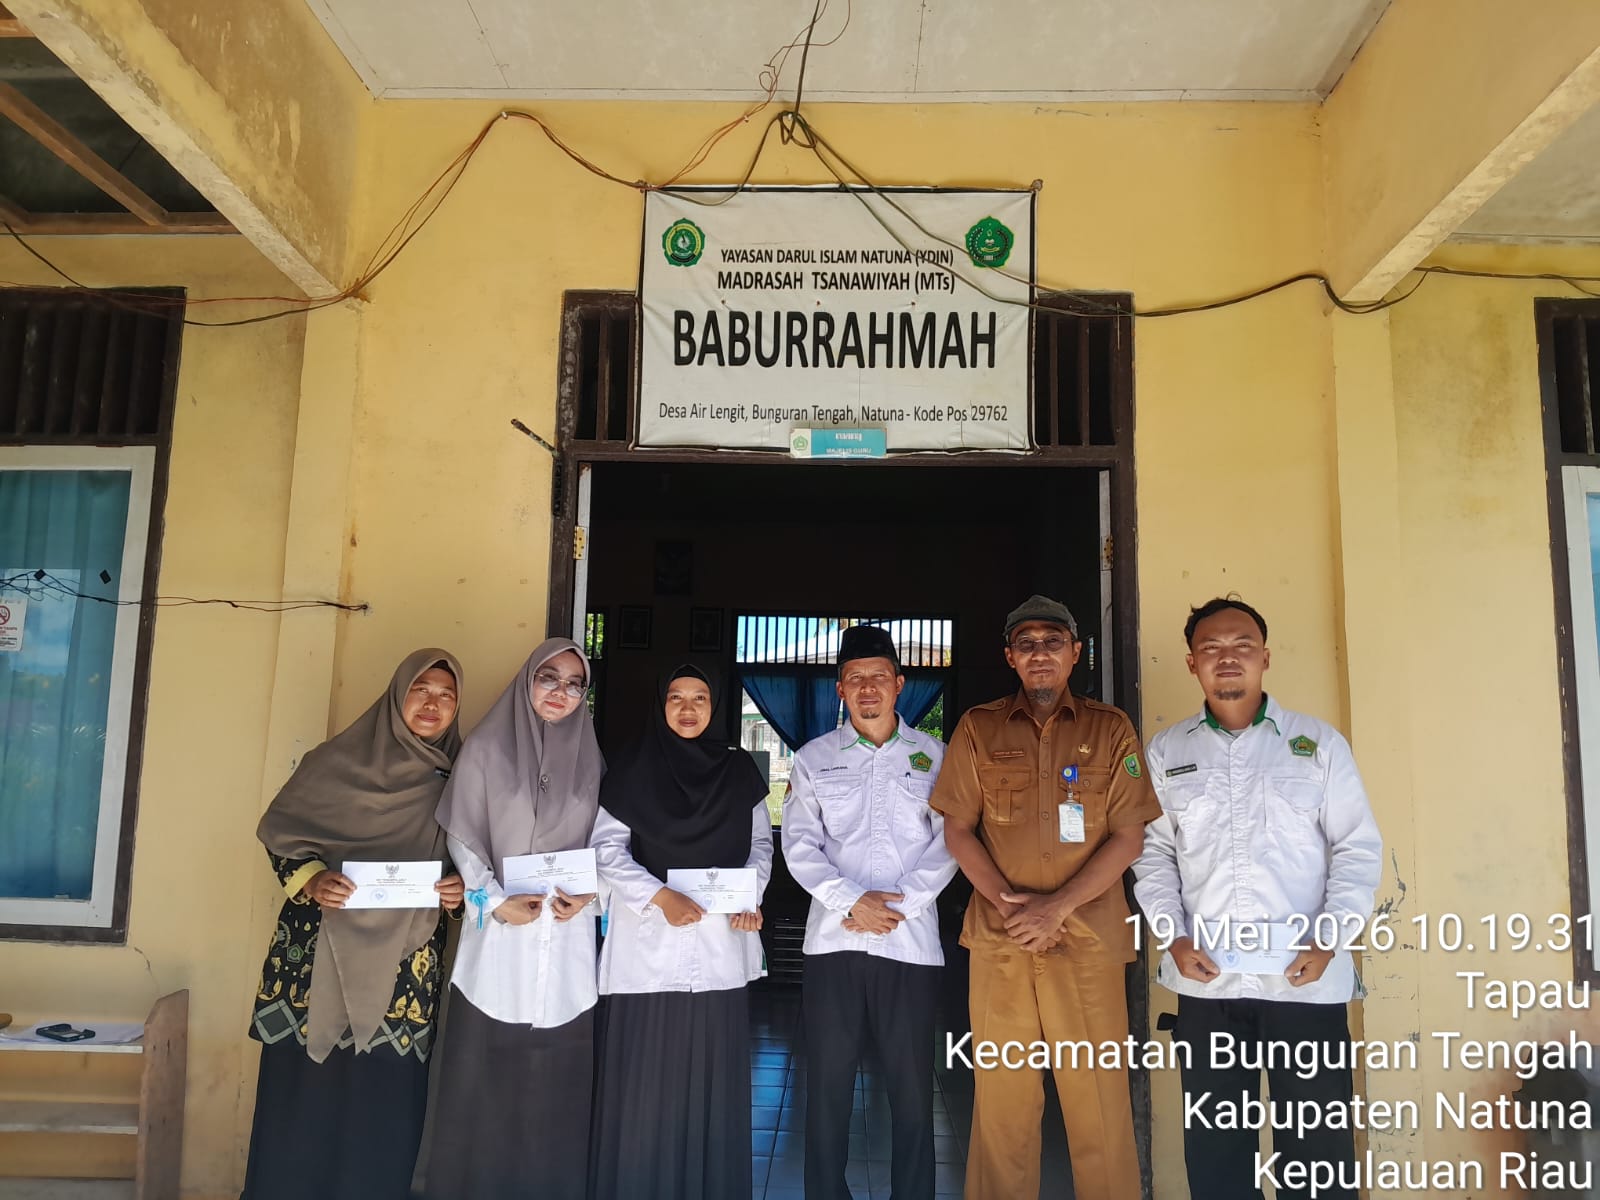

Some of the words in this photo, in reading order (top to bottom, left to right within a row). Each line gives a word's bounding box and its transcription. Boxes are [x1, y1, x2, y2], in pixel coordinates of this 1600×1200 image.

[720, 249, 774, 264] YAYASAN
[776, 249, 817, 264] DARUL
[820, 249, 858, 264] ISLAM
[860, 249, 912, 264] NATUNA
[915, 249, 954, 267] (YDIN)
[717, 270, 804, 290] MADRASAH
[811, 271, 910, 291] TSANAWIYAH
[673, 309, 997, 369] BABURRAHMAH
[659, 402, 687, 419] Desa
[689, 402, 707, 419] Air
[710, 403, 748, 424] Lengit,
[752, 404, 808, 424] Bunguran
[811, 405, 857, 425] Tengah,
[914, 405, 944, 422] Kode
[947, 405, 968, 422] Pos
[971, 405, 1008, 422] 29762
